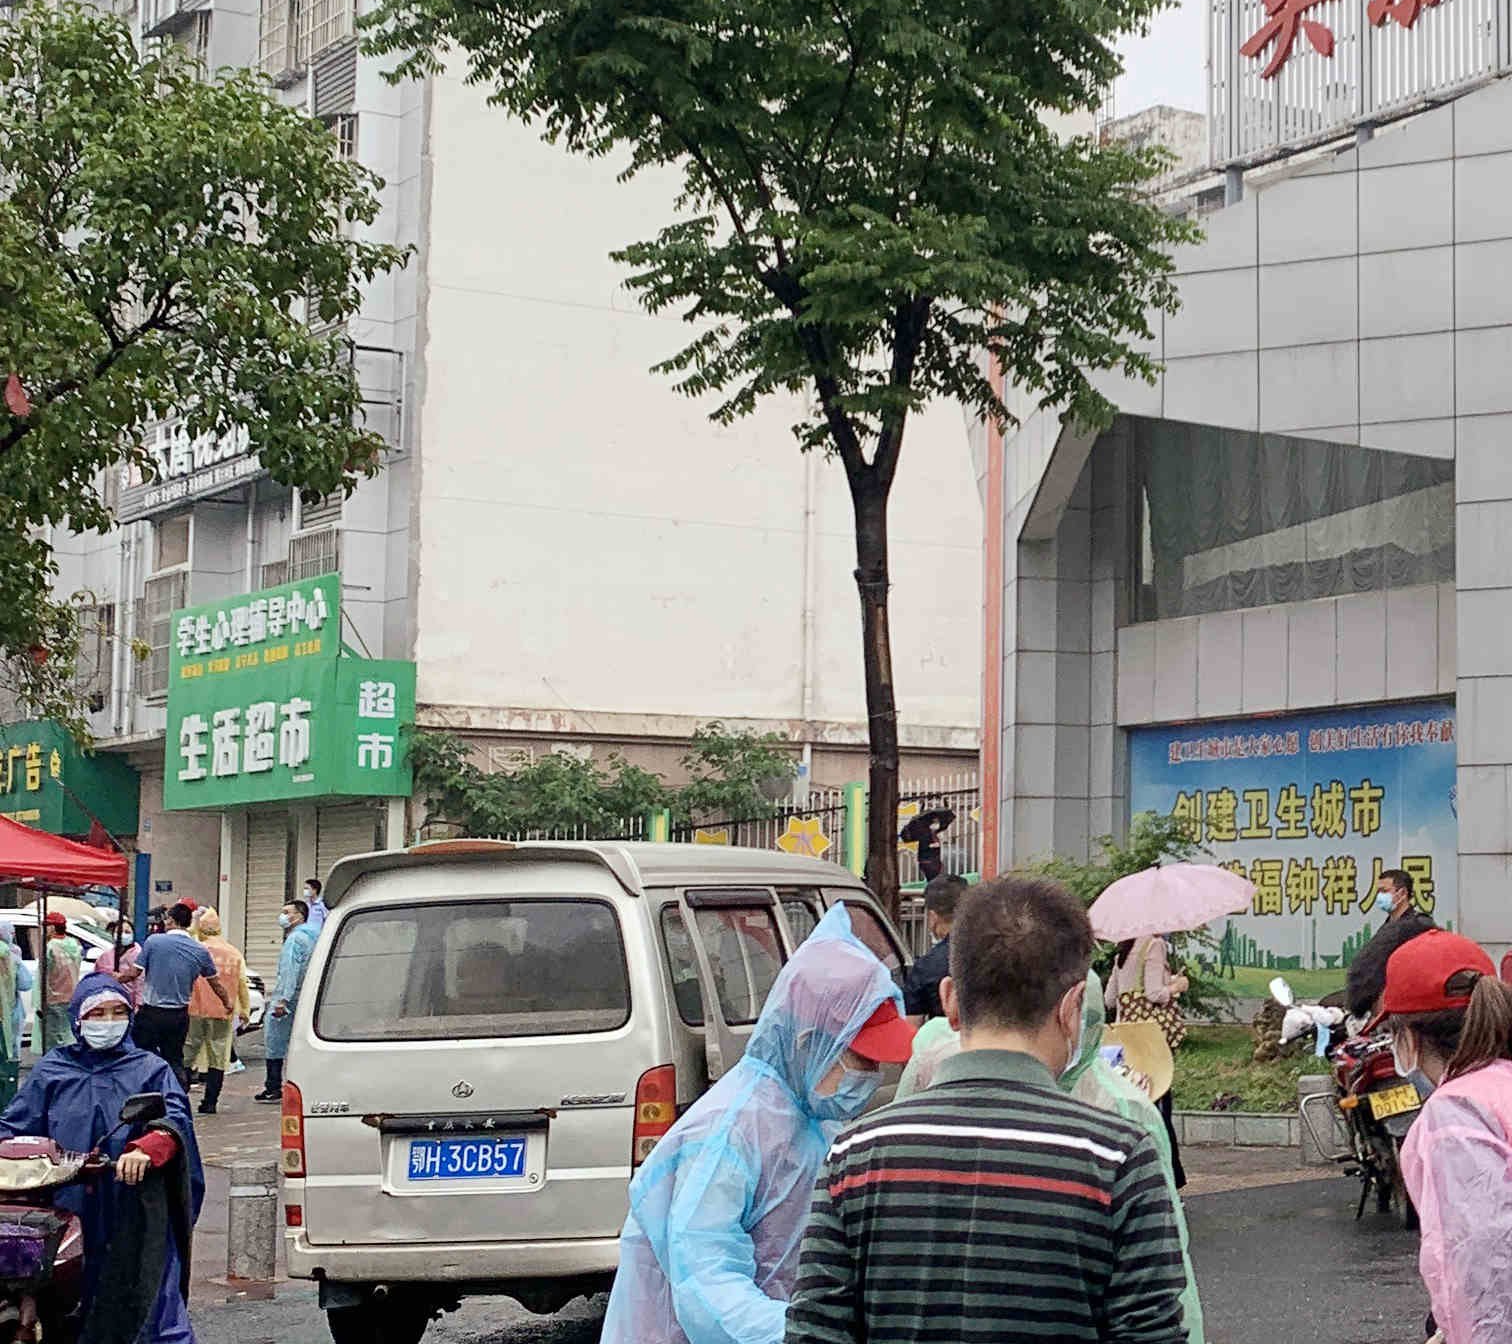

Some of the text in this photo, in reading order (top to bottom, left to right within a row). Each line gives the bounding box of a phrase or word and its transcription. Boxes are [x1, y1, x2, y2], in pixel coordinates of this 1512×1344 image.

[177, 587, 328, 657] 学生心理辅导中心
[178, 697, 313, 781] 生活超市
[357, 681, 395, 769] 超市
[1172, 779, 1386, 844] 创建卫生城市
